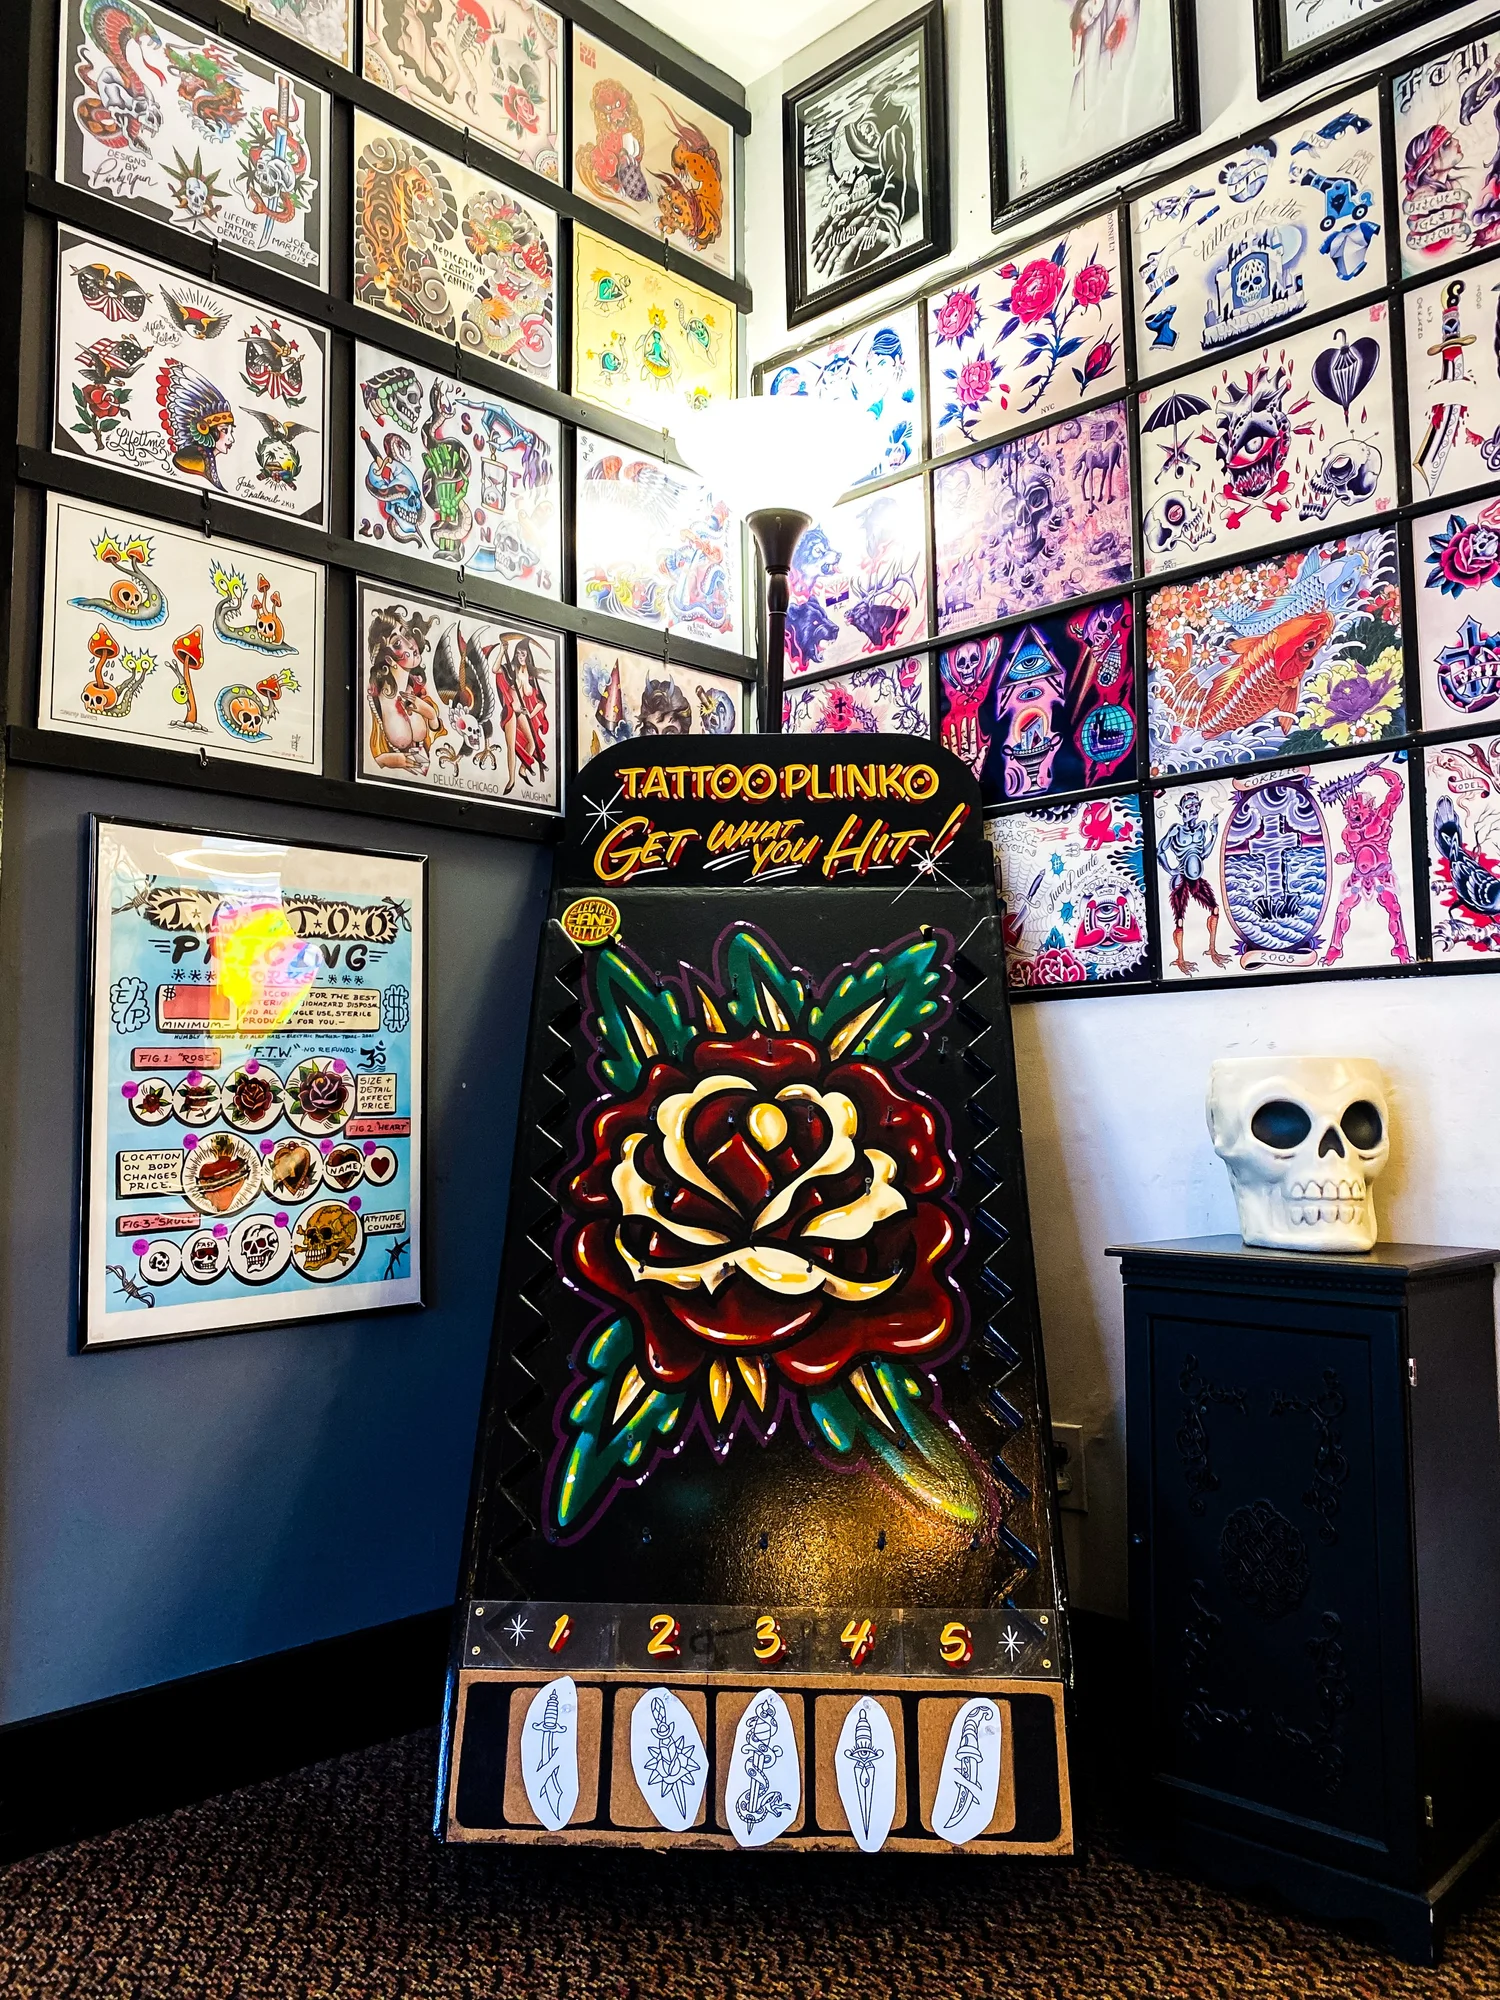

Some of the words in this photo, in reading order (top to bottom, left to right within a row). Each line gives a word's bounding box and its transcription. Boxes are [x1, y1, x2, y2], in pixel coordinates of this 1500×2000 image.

[1308, 134, 1326, 148] NYC
[107, 149, 147, 168] DESIGNS
[125, 163, 138, 171] BY
[223, 211, 258, 231] LIFETIME
[217, 226, 256, 248] DENVER
[224, 221, 253, 239] TATTOO
[272, 237, 317, 262] MARTINEZ
[286, 237, 306, 249] JOE
[285, 250, 306, 265] 2013
[432, 242, 486, 277] DEDICATION
[442, 258, 475, 281] TATTOO
[1040, 403, 1056, 415] NYC
[1453, 663, 1500, 686] FAIT
[433, 773, 464, 789] DELUXE
[467, 780, 499, 794] CHICAGO
[615, 763, 777, 801] TATTOO
[781, 763, 940, 801] PLINKO
[984, 819, 1014, 831] EMORY
[1015, 820, 1028, 829] OF
[752, 834, 823, 877] YOU
[569, 901, 615, 917] ELECTRIC
[567, 912, 615, 926] HAND
[567, 922, 613, 940] TATTOO
[1087, 950, 1129, 963] FOREVER
[1260, 952, 1295, 963] 2005
[242, 1017, 293, 1025] PRODUCS
[360, 1077, 382, 1085] SIZE
[360, 1086, 392, 1094] DETAIL
[122, 1153, 181, 1163] LOCATION
[148, 1162, 178, 1171] BODY
[330, 1163, 358, 1175] NAME
[123, 1172, 178, 1181] CHANGES
[364, 1213, 402, 1223] ATTITUDE
[196, 1241, 215, 1249] FAST
[547, 1613, 575, 1653] 1
[646, 1613, 681, 1660] 2
[753, 1615, 787, 1664] 3
[840, 1618, 876, 1668] 4
[939, 1621, 973, 1668] 5
